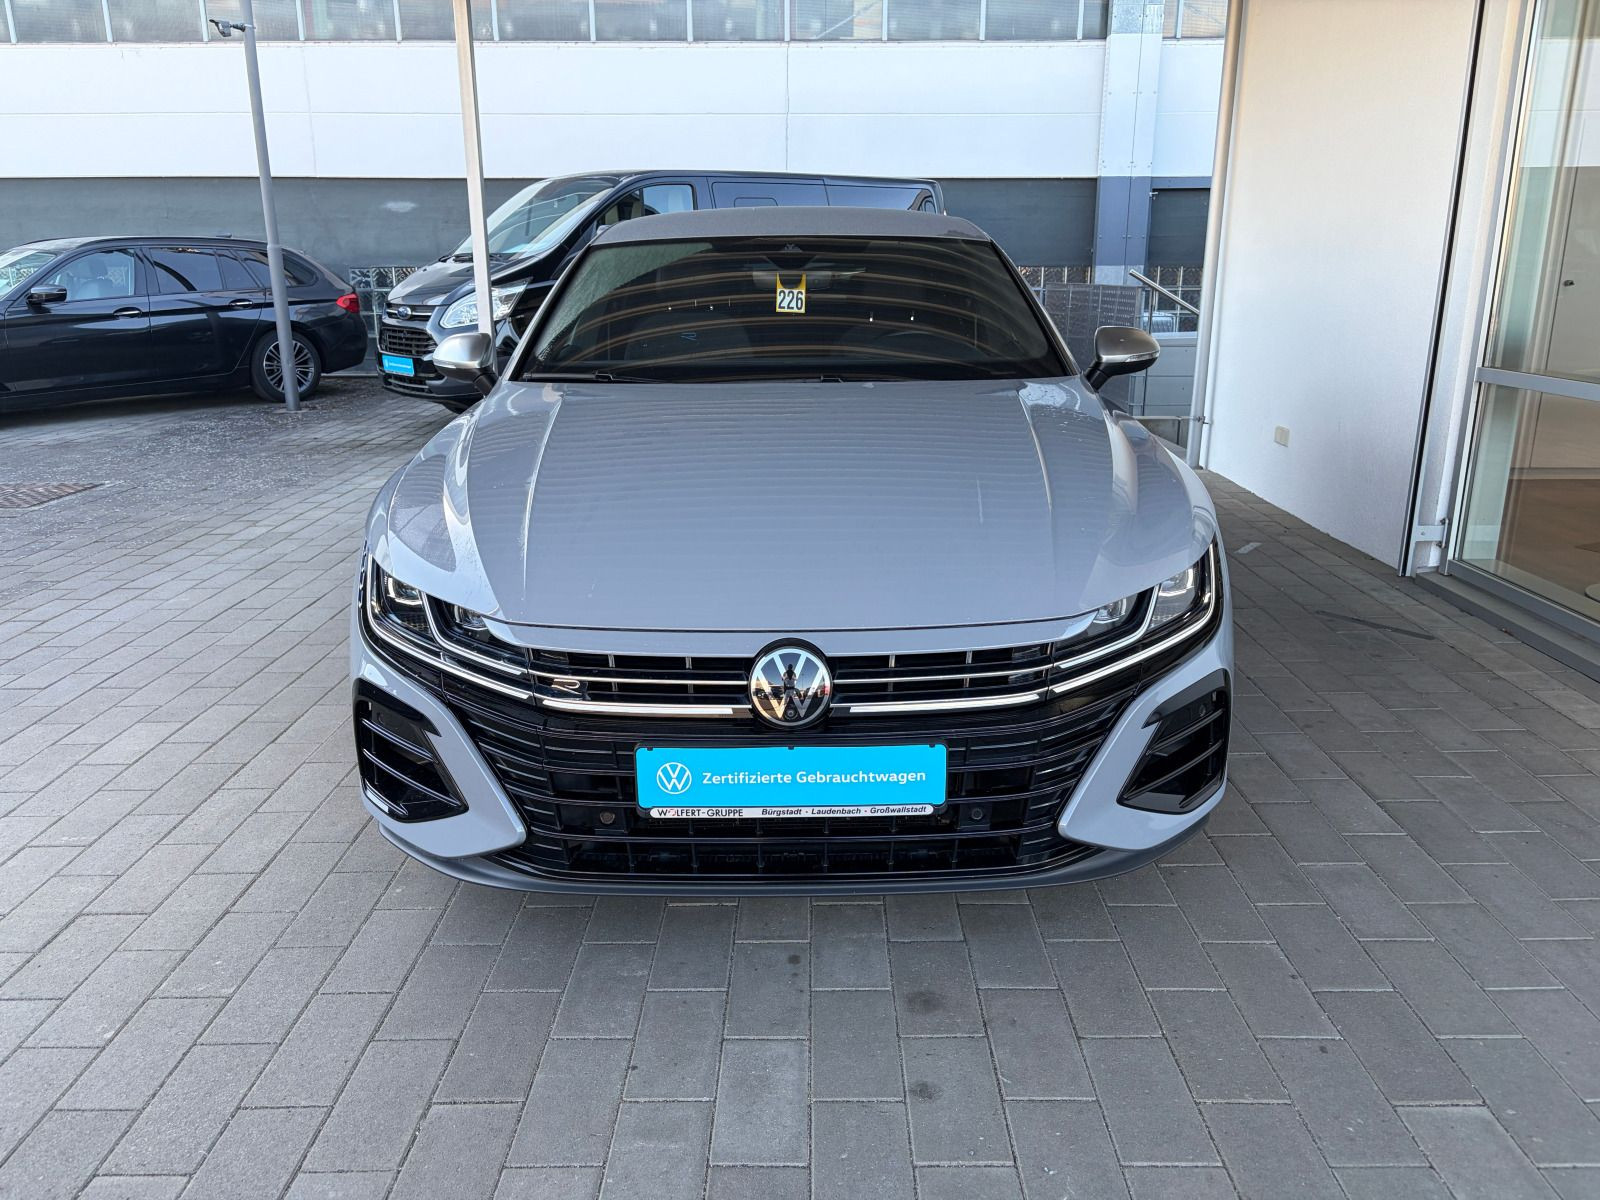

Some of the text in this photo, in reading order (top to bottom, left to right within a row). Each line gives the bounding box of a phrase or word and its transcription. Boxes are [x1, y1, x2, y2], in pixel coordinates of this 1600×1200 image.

[778, 290, 804, 311] 226
[702, 770, 927, 785] Zertifizierte Gebrauchtwagen
[761, 807, 803, 817] Bürgstadt
[811, 807, 862, 815] Laudenbach
[869, 805, 927, 815] Großwallstadt
